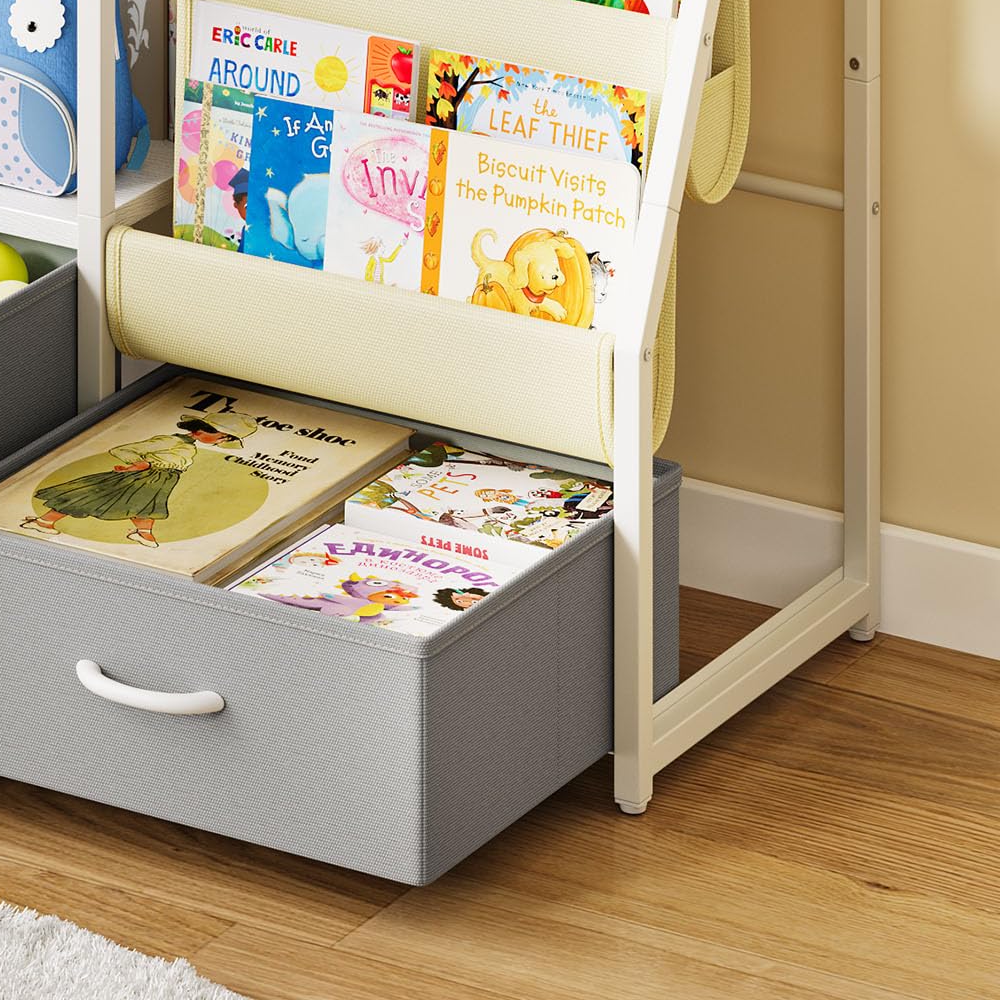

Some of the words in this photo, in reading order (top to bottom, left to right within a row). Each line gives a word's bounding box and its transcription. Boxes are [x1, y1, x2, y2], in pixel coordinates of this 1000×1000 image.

[254, 35, 298, 57] CARLE
[208, 57, 301, 97] AROUND
[532, 98, 558, 118] the
[283, 116, 301, 137] If
[489, 108, 541, 139] LEAF
[549, 121, 610, 153] THIEF
[477, 151, 548, 185] Biscuit
[549, 166, 608, 197] Visits
[455, 178, 488, 201] the
[493, 185, 568, 219] Pumpkin
[572, 199, 627, 229] Patch
[294, 426, 357, 447] shoe
[224, 455, 300, 478] Childhood
[250, 451, 311, 472] Memory
[278, 450, 320, 465] Fond
[249, 470, 289, 485] Story
[411, 470, 443, 489] SOME
[416, 471, 477, 501] PETS
[420, 535, 453, 551] PETS
[455, 543, 490, 561] SOME
